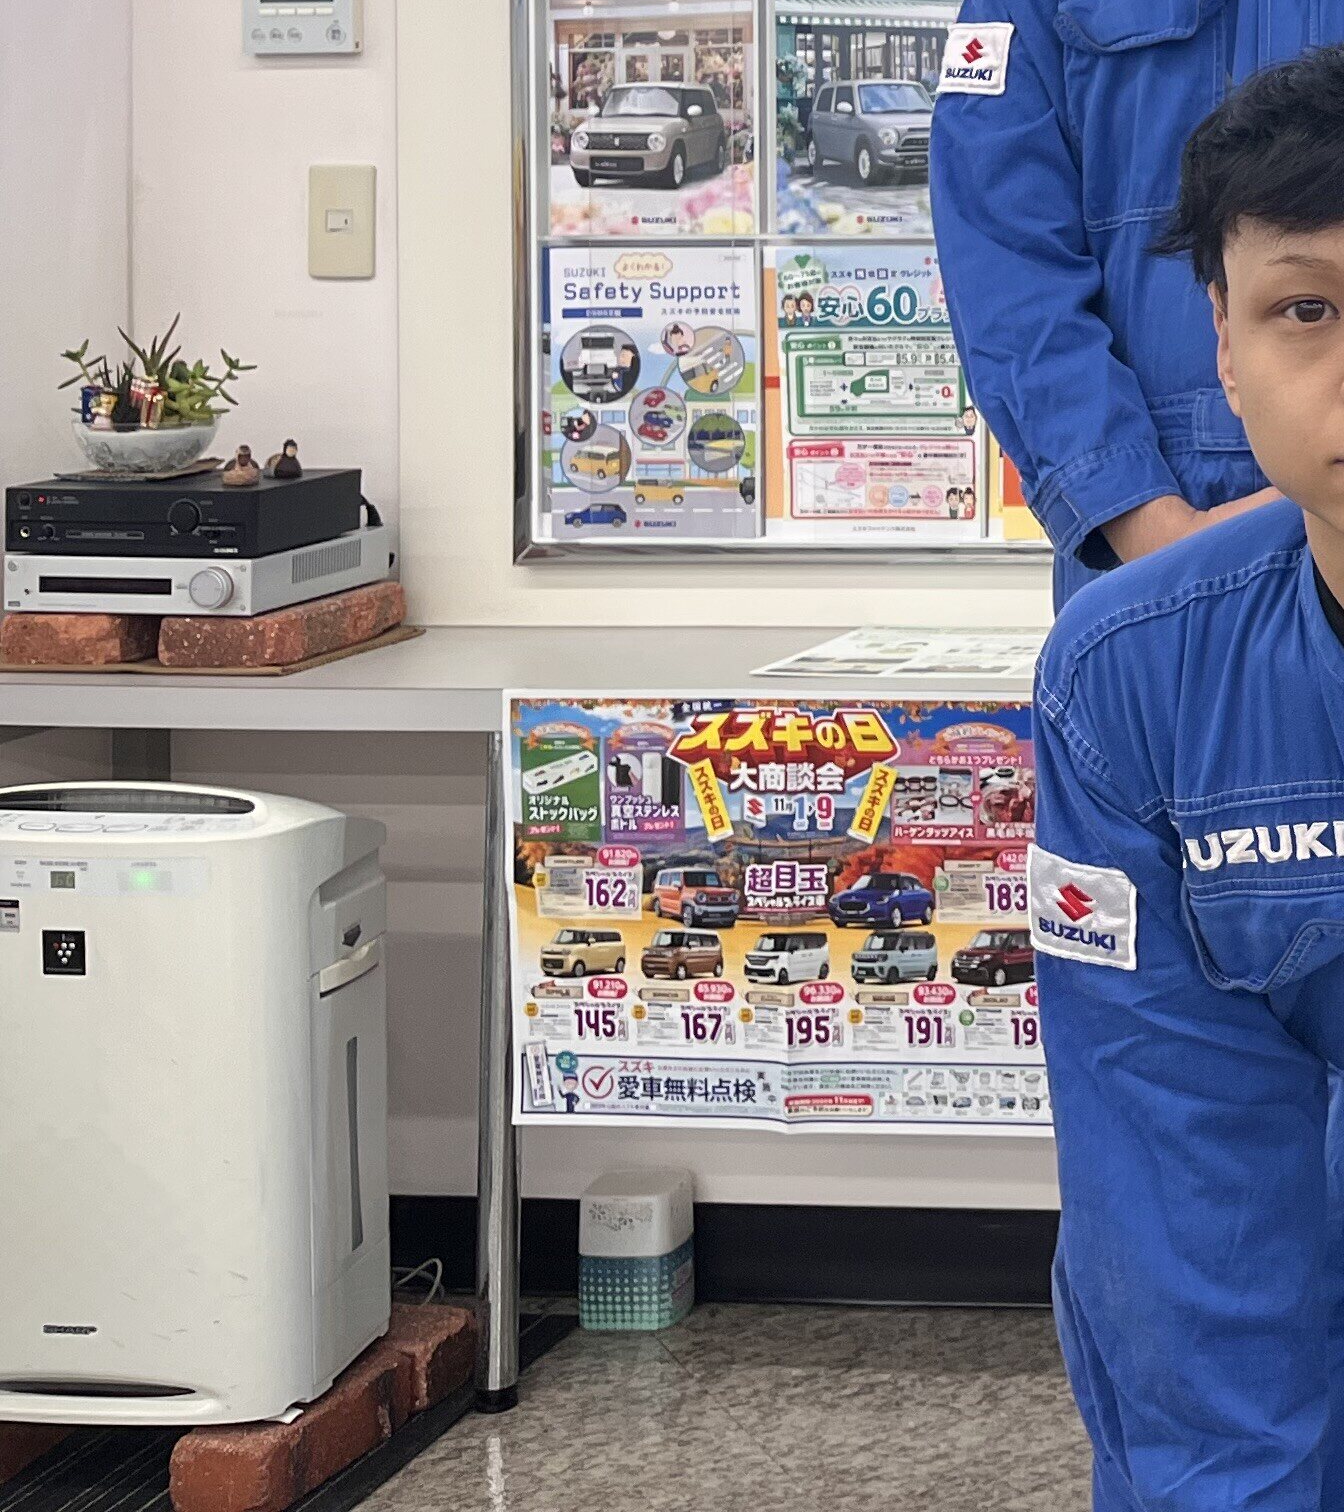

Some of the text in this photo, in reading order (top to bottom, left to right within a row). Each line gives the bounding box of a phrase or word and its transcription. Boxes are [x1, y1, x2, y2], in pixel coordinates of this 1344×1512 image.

[944, 67, 993, 81] SUZUKI
[641, 216, 677, 224] SUZUKI
[866, 215, 903, 223] SUZUKI
[563, 267, 606, 278] SUZUKI
[563, 281, 741, 303] Safety Support
[676, 712, 894, 753] スズキの日
[730, 761, 845, 792] 大商談会
[528, 795, 570, 806] オリジナル
[610, 805, 680, 818] 真空ステンレス
[694, 766, 725, 830] スズキの日
[859, 768, 890, 832] スズキの日
[528, 806, 598, 822] ストックバッグ
[610, 819, 638, 831] ボトル
[894, 826, 975, 838] ハーゲンダッツアイス
[585, 878, 627, 907] 162
[747, 864, 826, 894] 超目玉
[985, 883, 1028, 911] 183
[1038, 916, 1117, 952] SUZUKI
[574, 1009, 616, 1038] 145
[681, 1013, 722, 1040] 167
[786, 1015, 830, 1045] 195
[904, 1015, 943, 1044] 191
[1010, 1017, 1038, 1046] 19
[618, 1060, 654, 1073] スズキ
[617, 1074, 757, 1104] 愛車無料点検
